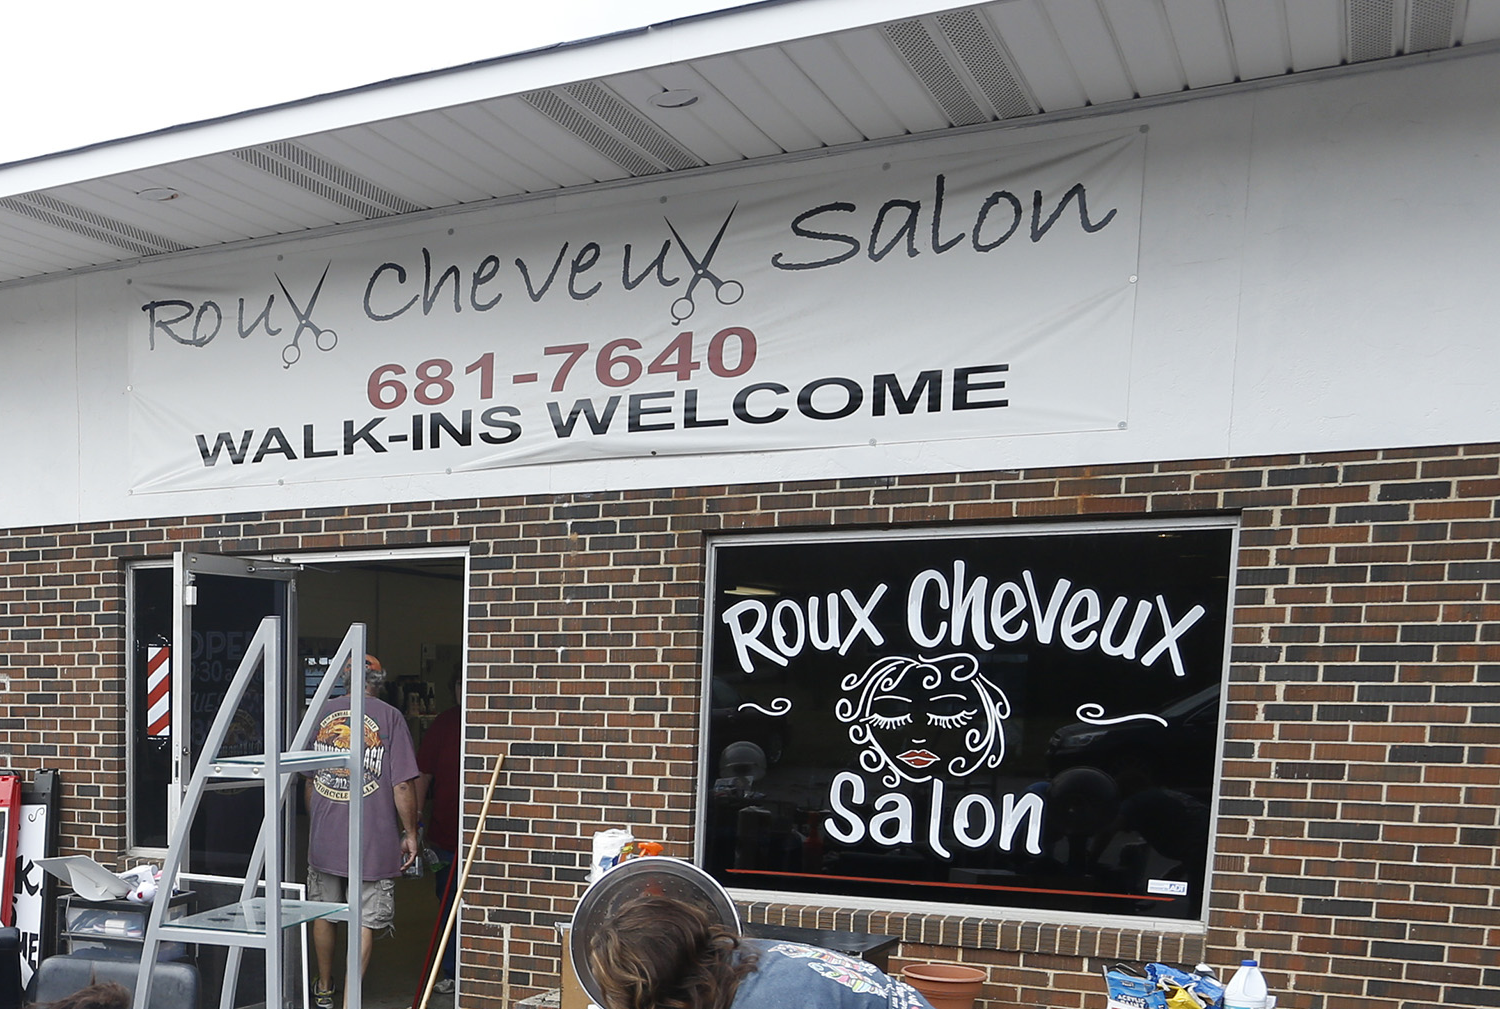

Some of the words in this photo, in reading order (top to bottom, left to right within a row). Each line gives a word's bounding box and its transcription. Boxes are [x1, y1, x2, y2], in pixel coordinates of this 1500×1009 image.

[771, 174, 1117, 271] Salon
[367, 326, 758, 410] 681-7640
[194, 405, 523, 468] WALK-INS
[546, 364, 1010, 440] WELCOME
[191, 631, 252, 660] OPE
[824, 771, 1045, 859] Salon
